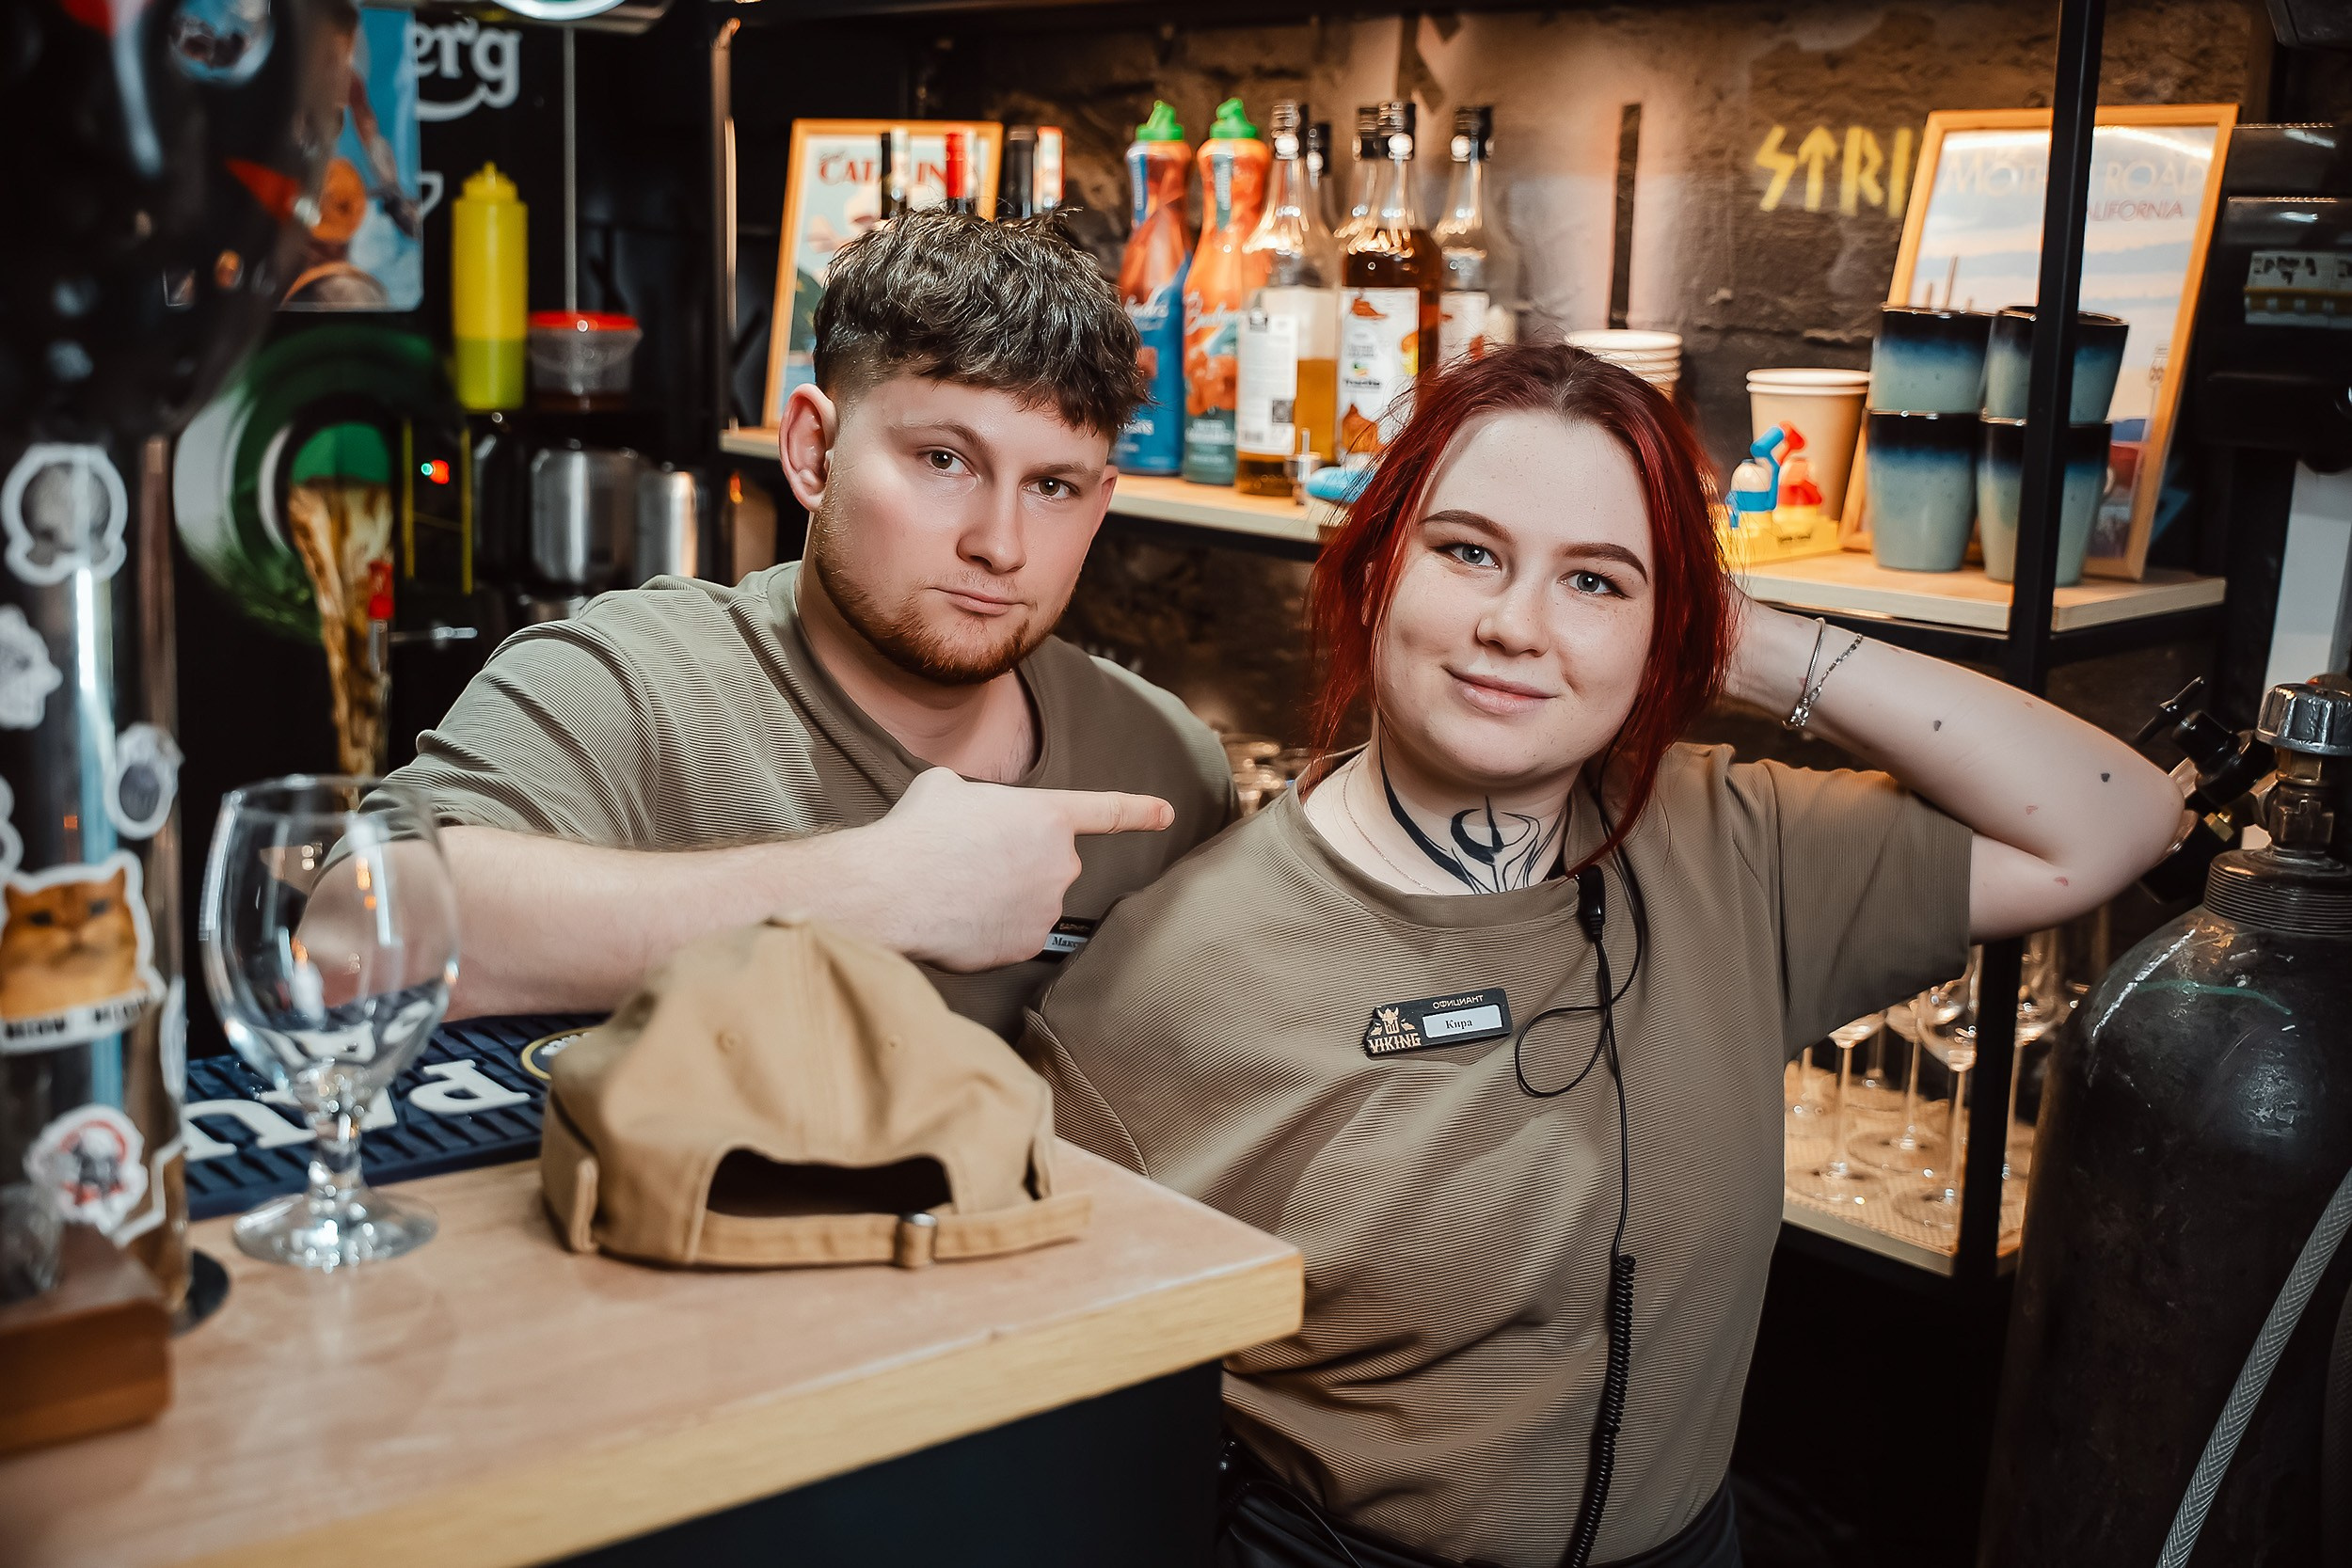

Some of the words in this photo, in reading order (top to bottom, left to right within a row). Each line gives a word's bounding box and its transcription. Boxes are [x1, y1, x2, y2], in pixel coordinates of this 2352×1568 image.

[2088, 199, 2184, 222] LIFORNIA
[1432, 994, 1485, 1010] ОФИЦИАНТ
[1445, 1018, 1474, 1031] Кира
[1367, 1032, 1422, 1054] VIKING
